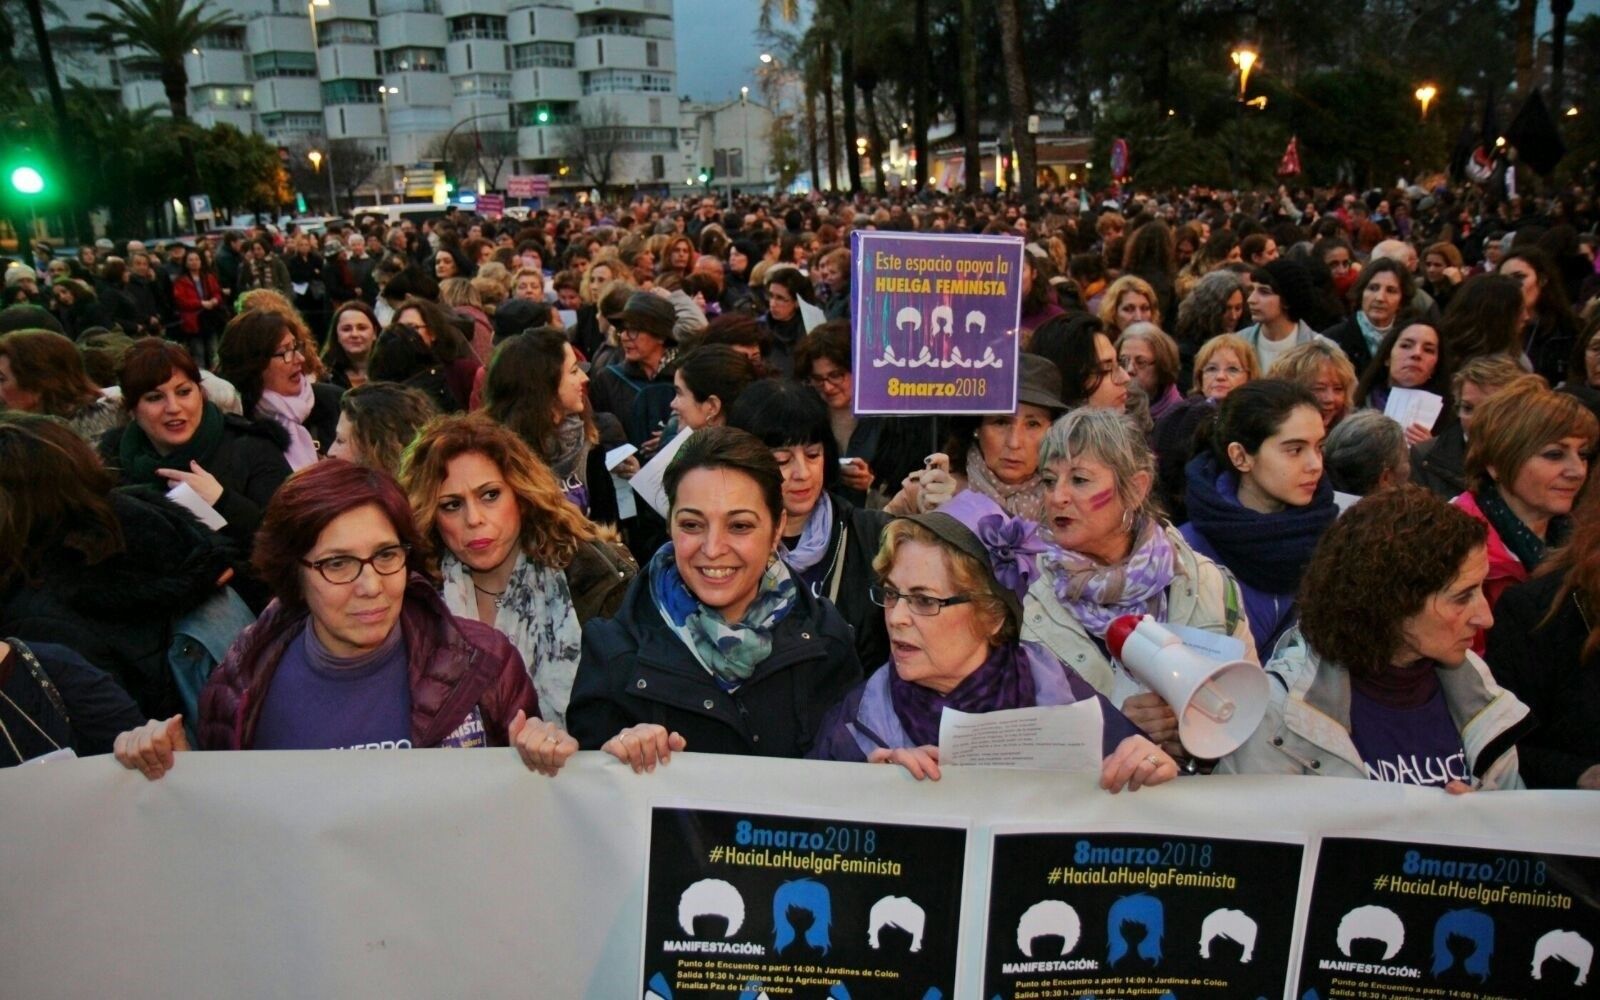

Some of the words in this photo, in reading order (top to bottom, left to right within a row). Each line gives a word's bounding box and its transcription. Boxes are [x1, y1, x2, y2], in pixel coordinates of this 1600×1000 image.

[876, 251, 901, 270] Este
[906, 255, 952, 275] espacio
[956, 259, 993, 278] apoya
[997, 254, 1009, 274] la
[875, 277, 931, 294] HUELGA
[936, 279, 1006, 295] FEMINISTA
[887, 377, 986, 397] 8marzo2018
[735, 820, 877, 854] 8marzo2018
[709, 845, 902, 876] #HaciaLaHuelgaFeminista
[1073, 840, 1212, 867] 8marzo2018
[1402, 849, 1547, 886] 8marzo2018
[1047, 867, 1236, 889] #HaciaLaHuelgaFeminista
[1373, 873, 1572, 910] #HaciaLaHuelgaFeminista
[663, 940, 766, 955] MANIFESTACIÓN:
[678, 960, 703, 968] Punto
[717, 961, 760, 970] Encuentro
[769, 964, 791, 972] partir
[794, 965, 815, 973] 14:00
[825, 967, 860, 976] Jardines
[874, 970, 899, 978] Colón
[1002, 958, 1099, 974] MANIFESTACIÓN:
[1319, 959, 1421, 978] MANIFESTACIÓN:
[677, 971, 703, 979] Salida
[705, 972, 727, 980] 19:30
[736, 973, 771, 982] Jardines
[774, 975, 784, 983] de
[795, 976, 840, 985] Agricultura
[1052, 978, 1093, 987] Encuentro
[1101, 977, 1123, 986] partir
[1125, 976, 1146, 984] 14:00
[1155, 977, 1189, 985] Jardines
[1203, 978, 1228, 987] Colón
[1332, 977, 1357, 987] Punto
[1371, 981, 1414, 992] Encuentro
[1423, 987, 1446, 995] partir
[676, 981, 708, 990] Finaliza
[752, 984, 793, 994] Corredera
[1015, 990, 1039, 999] Salida
[1041, 989, 1062, 997] 19:30
[1071, 987, 1104, 996] Jardines
[1126, 987, 1171, 996] Agricultura
[1330, 988, 1356, 997] Salida
